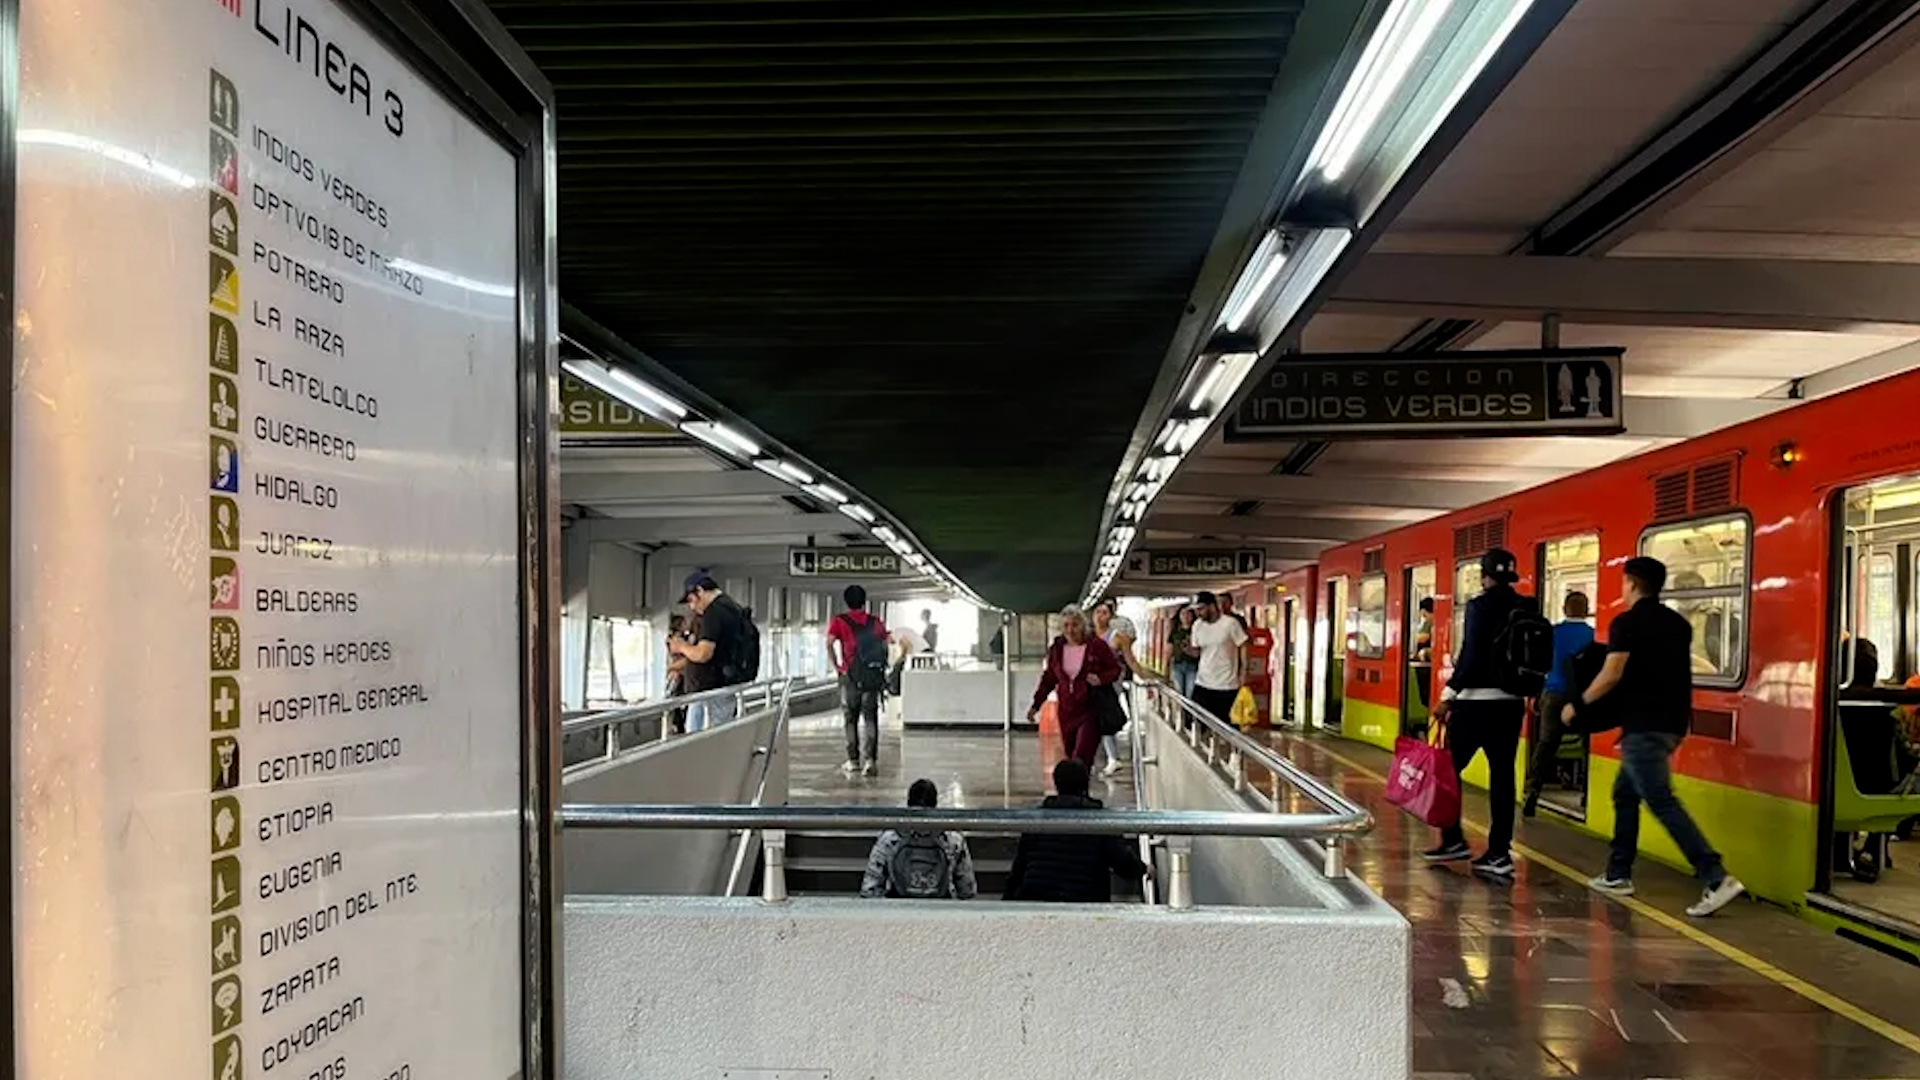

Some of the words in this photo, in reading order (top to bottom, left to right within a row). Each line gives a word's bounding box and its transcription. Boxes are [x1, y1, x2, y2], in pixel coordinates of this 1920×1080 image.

[254, 0, 372, 118] LINEA
[383, 88, 405, 138] 3
[252, 125, 314, 182] INDIOS
[320, 168, 388, 229] VERDES
[253, 241, 344, 304] POTRERO
[343, 236, 366, 265] DE
[253, 300, 281, 332] LA
[295, 317, 344, 357] RAZA
[254, 358, 378, 418] TLATELOLCO
[1270, 367, 1514, 389] DIRECCION
[1252, 396, 1368, 421] INDIOS
[1384, 393, 1533, 418] VERDES
[254, 416, 357, 462] GUERRERO
[255, 473, 338, 509] HIDALGO
[820, 554, 898, 571] SALIDA
[1153, 556, 1233, 572] SALIDA
[256, 589, 359, 613] BALDERAS
[257, 637, 315, 669] NIÑOS
[323, 641, 391, 665] HEROES
[257, 691, 352, 725] HOSPITAL
[356, 684, 428, 711] GENERAL
[258, 748, 337, 784] CENTRO
[340, 738, 402, 767] MEDICO
[258, 801, 334, 842] ETIOPIA
[259, 851, 342, 899] EUGENIA
[260, 904, 339, 957] DIVISION
[345, 890, 379, 920] DEL
[386, 873, 419, 903] NTE
[260, 956, 341, 1015] ZAPATA
[261, 996, 365, 1072] COYOACAN
